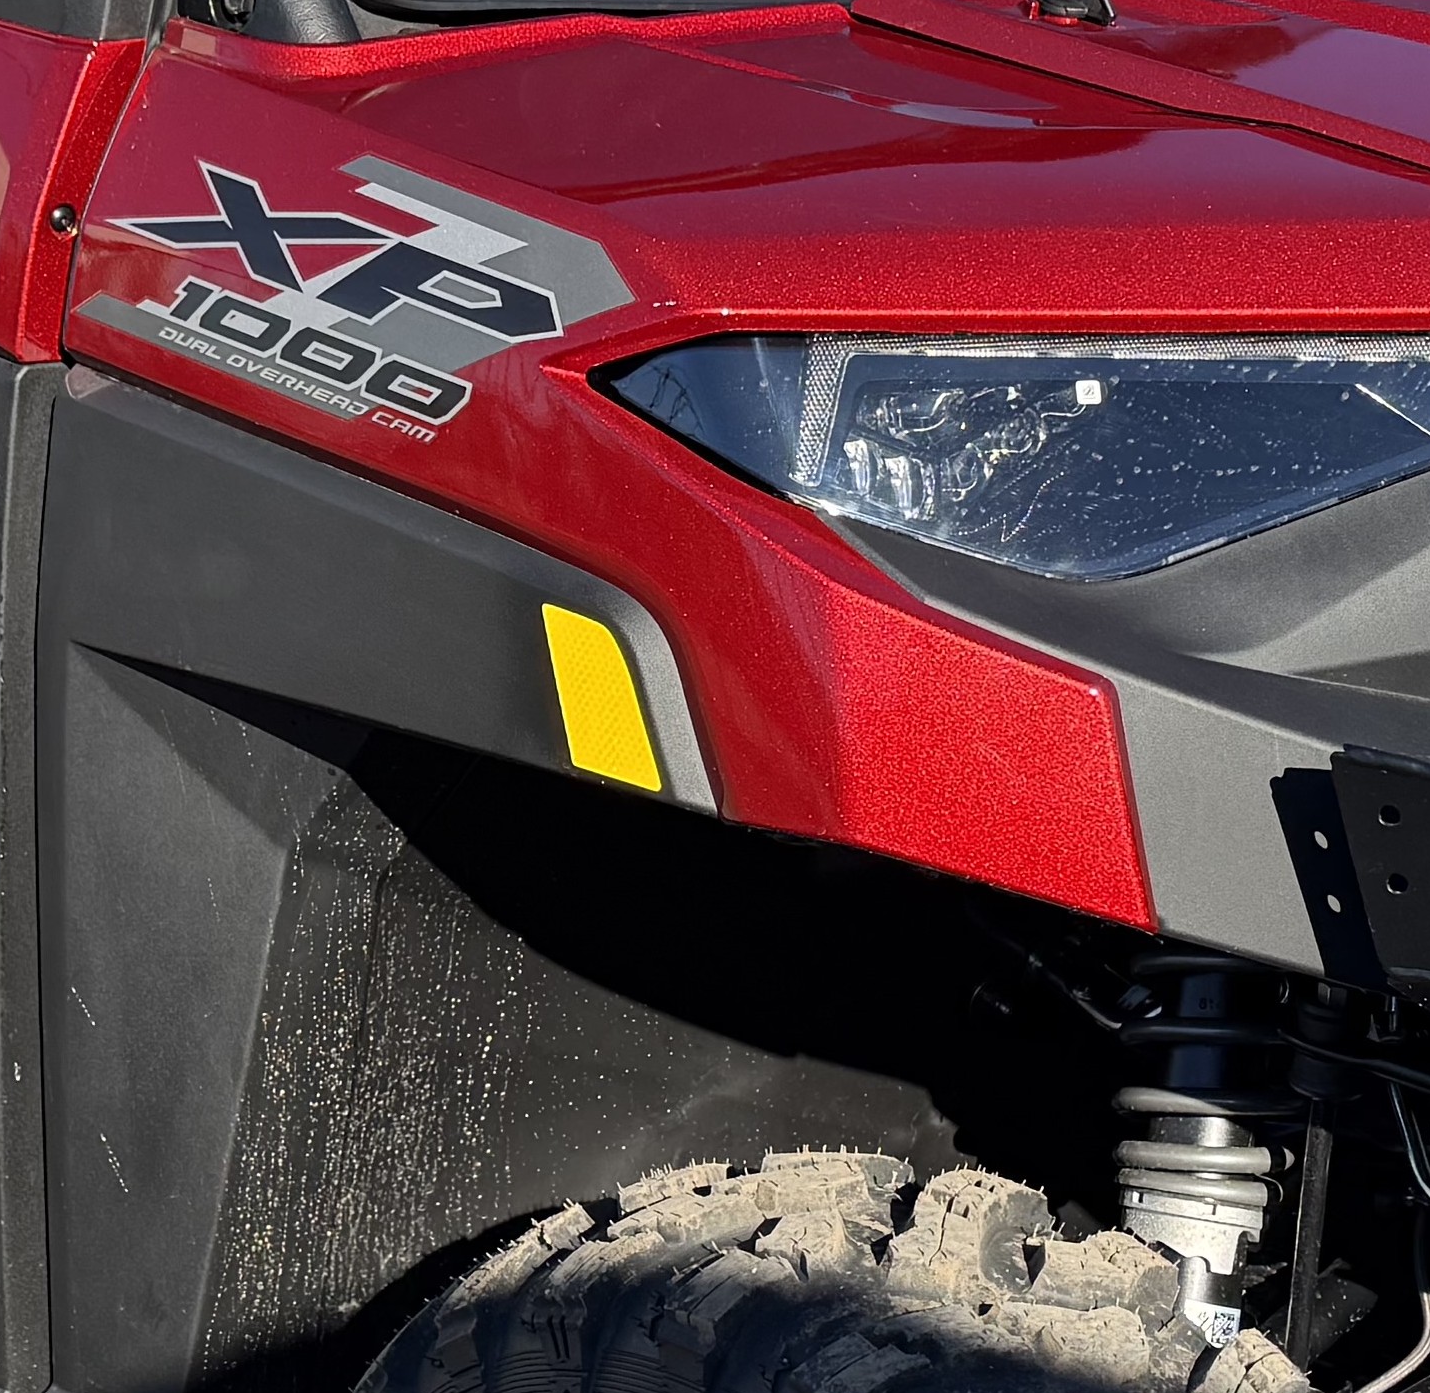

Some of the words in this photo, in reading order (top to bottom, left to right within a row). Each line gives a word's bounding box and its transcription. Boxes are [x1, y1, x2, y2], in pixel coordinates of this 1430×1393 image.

[105, 161, 565, 342] XP
[158, 325, 222, 362] DUAL
[225, 350, 369, 418] OVERHEAD
[371, 410, 438, 445] CAM
[167, 277, 472, 426] 1000
